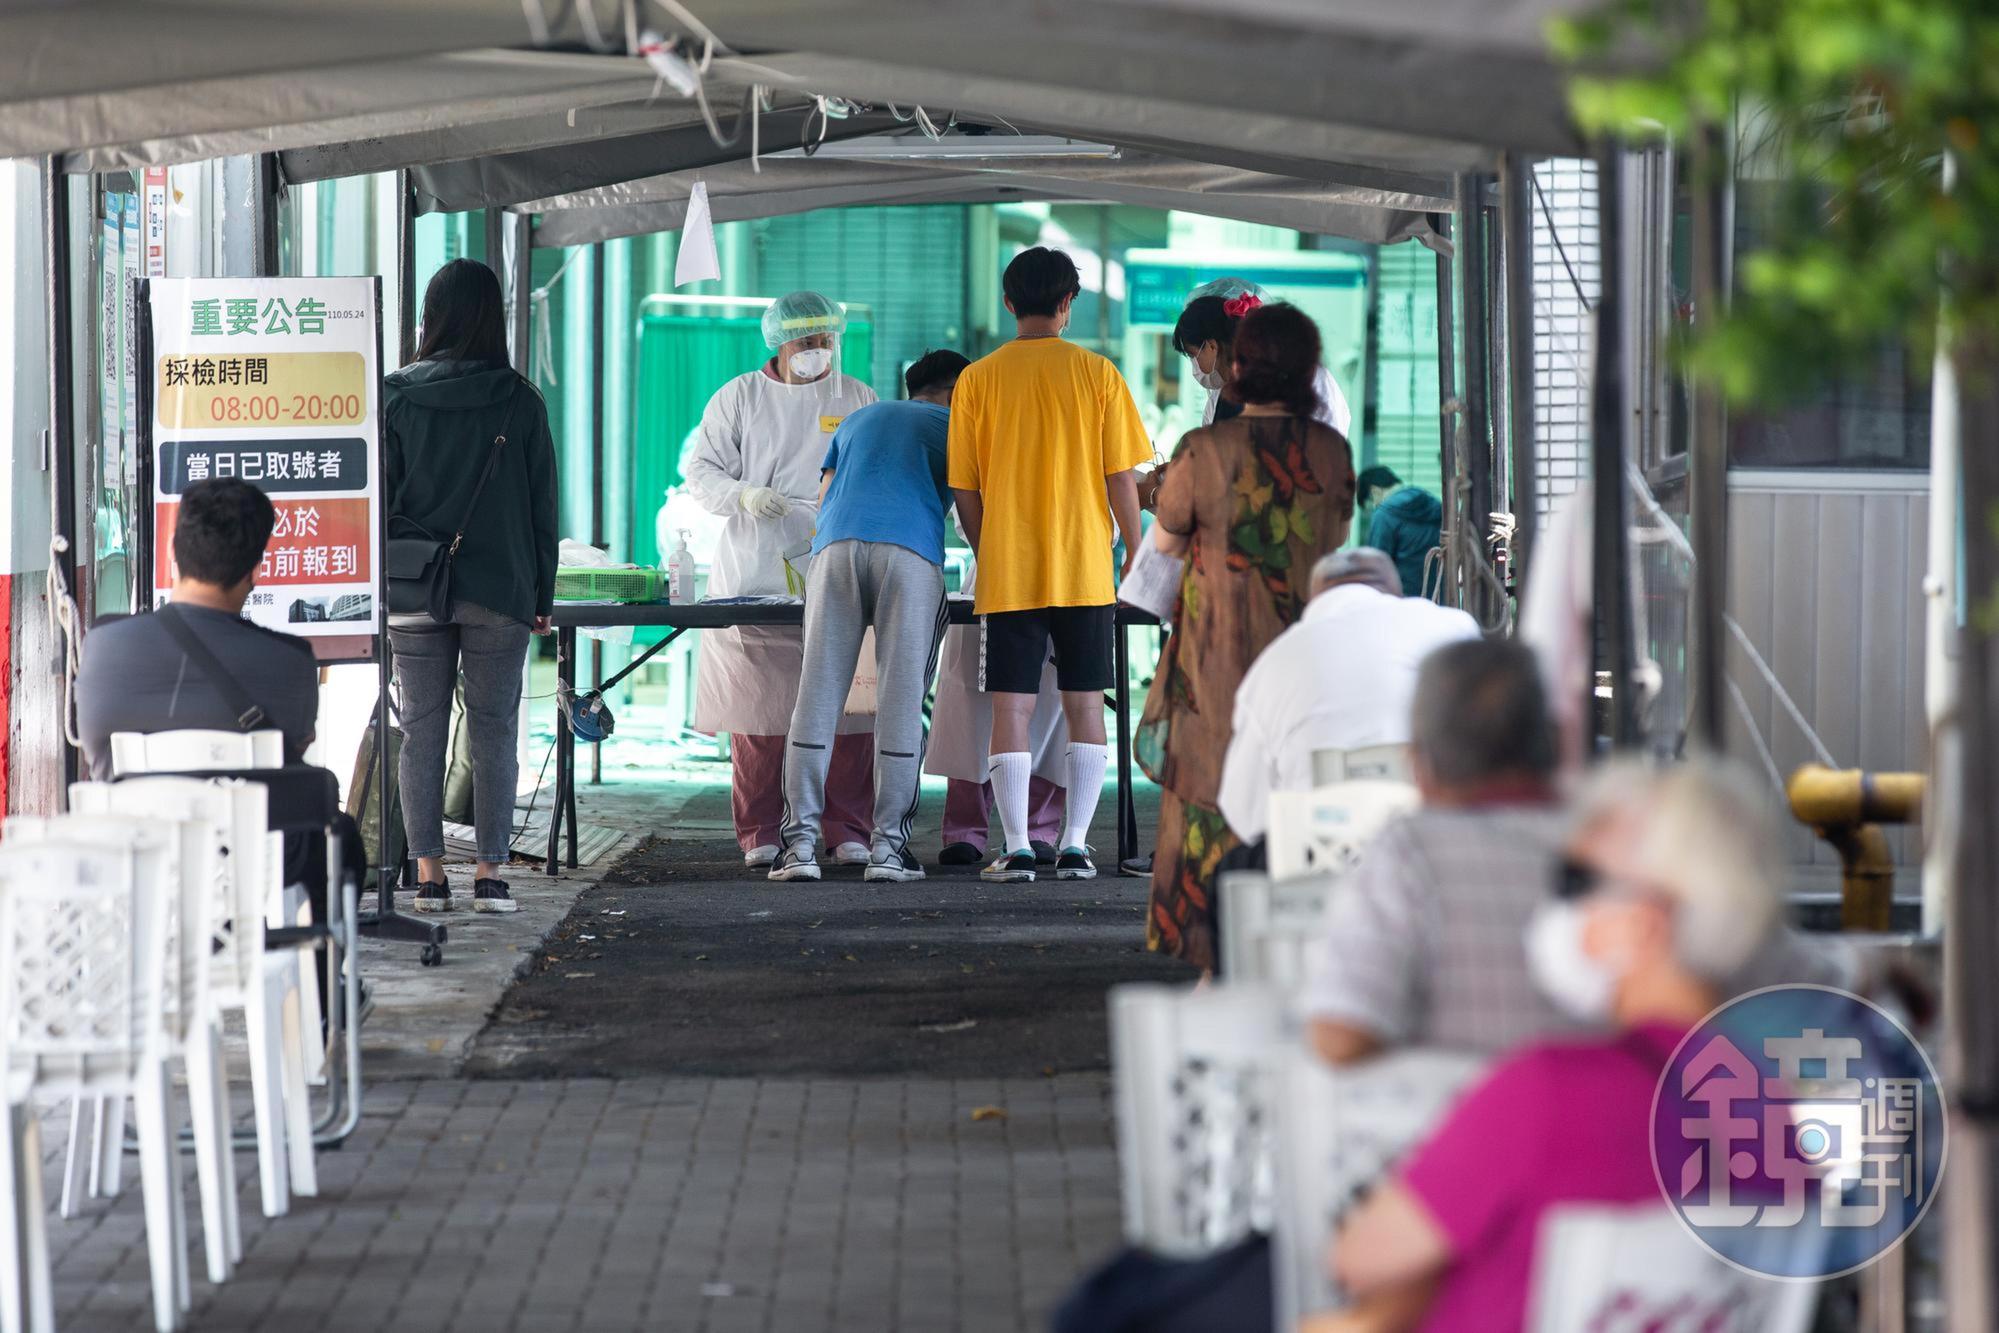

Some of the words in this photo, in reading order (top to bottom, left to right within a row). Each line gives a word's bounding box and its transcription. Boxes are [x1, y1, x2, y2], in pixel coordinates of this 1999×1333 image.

[191, 297, 327, 336] 重要公告
[327, 310, 365, 320] 110.05.24
[165, 358, 268, 386] 採檢時間
[210, 394, 360, 421] 08:00-20:00
[186, 450, 342, 482] 當日已取號者
[272, 506, 320, 537] 必於
